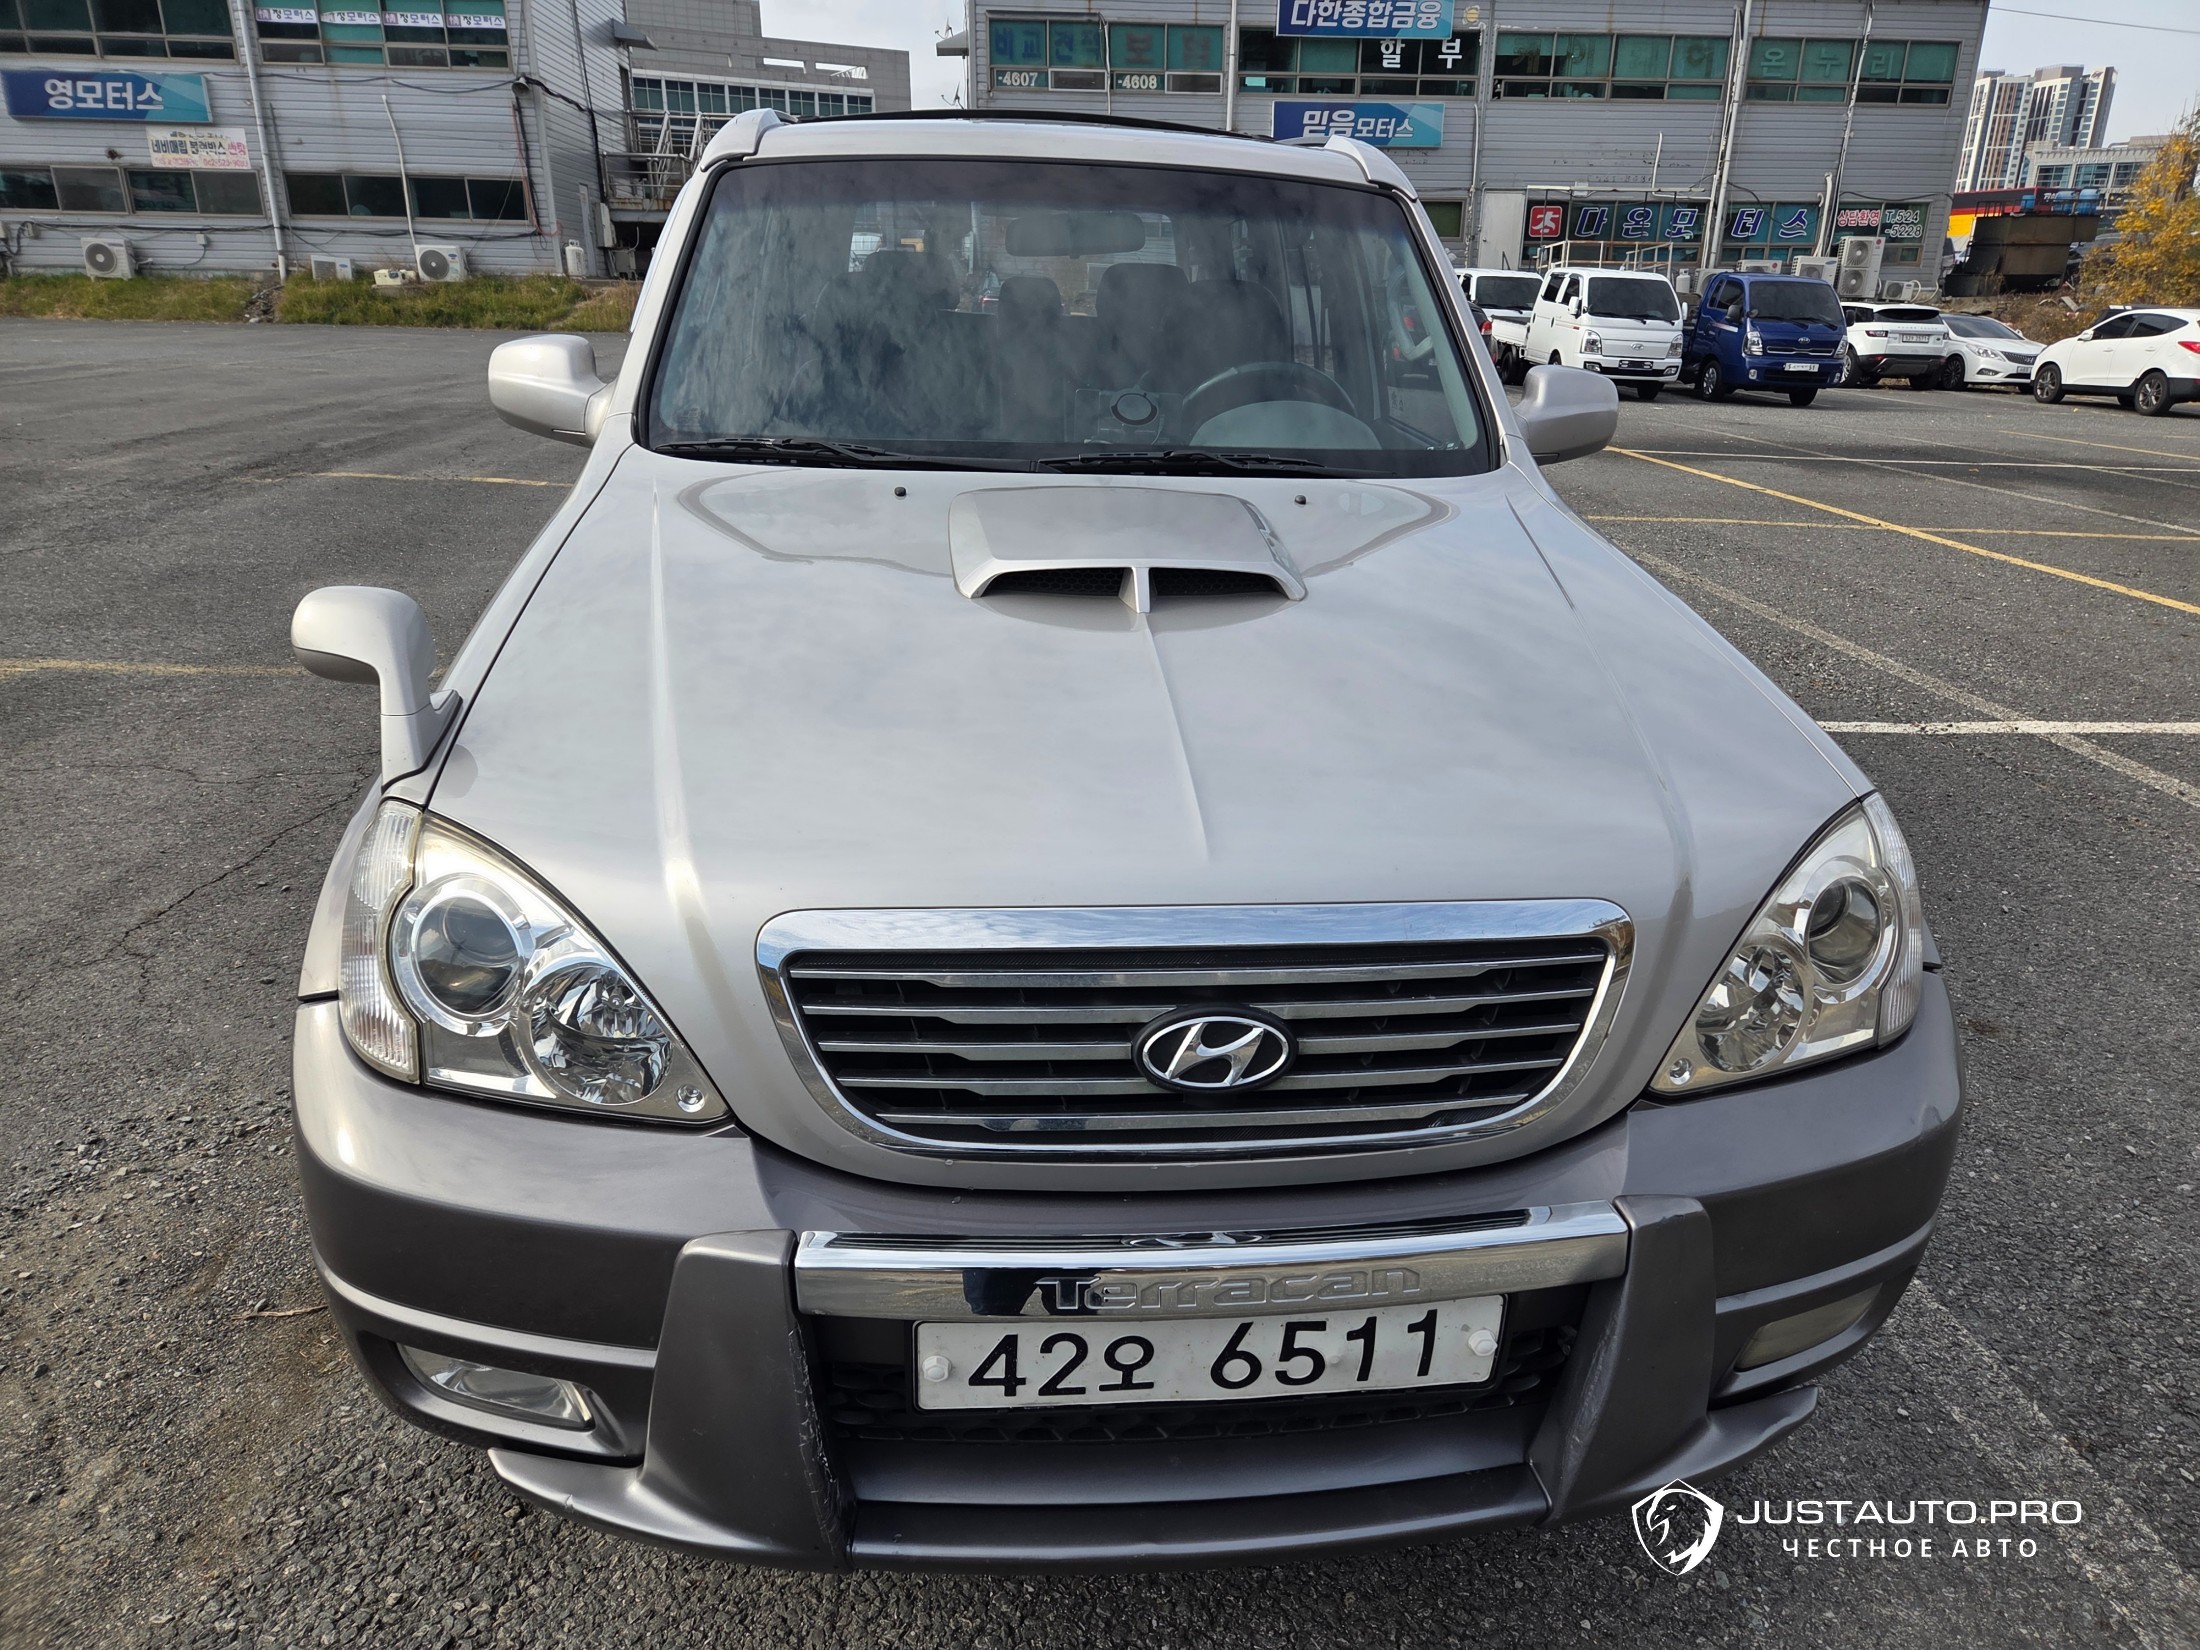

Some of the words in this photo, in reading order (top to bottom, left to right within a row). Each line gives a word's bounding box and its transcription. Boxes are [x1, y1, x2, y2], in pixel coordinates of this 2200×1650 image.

[273, 9, 314, 20] 정모터스
[337, 12, 377, 22] 정모터스
[400, 14, 440, 24] 정모터스
[463, 16, 503, 26] 정모터스
[1290, 0, 1442, 29] 다한종합금융
[998, 72, 1038, 87] -4607
[1118, 75, 1158, 90] -4608
[44, 79, 164, 110] 영모터스
[1838, 210, 1880, 226] 상담환영
[1885, 209, 1920, 225] T.524
[1885, 225, 1923, 238] -5228
[1035, 1268, 1421, 1310] Terracan
[967, 1332, 1156, 1398] 42오
[1209, 1309, 1439, 1390] 6511
